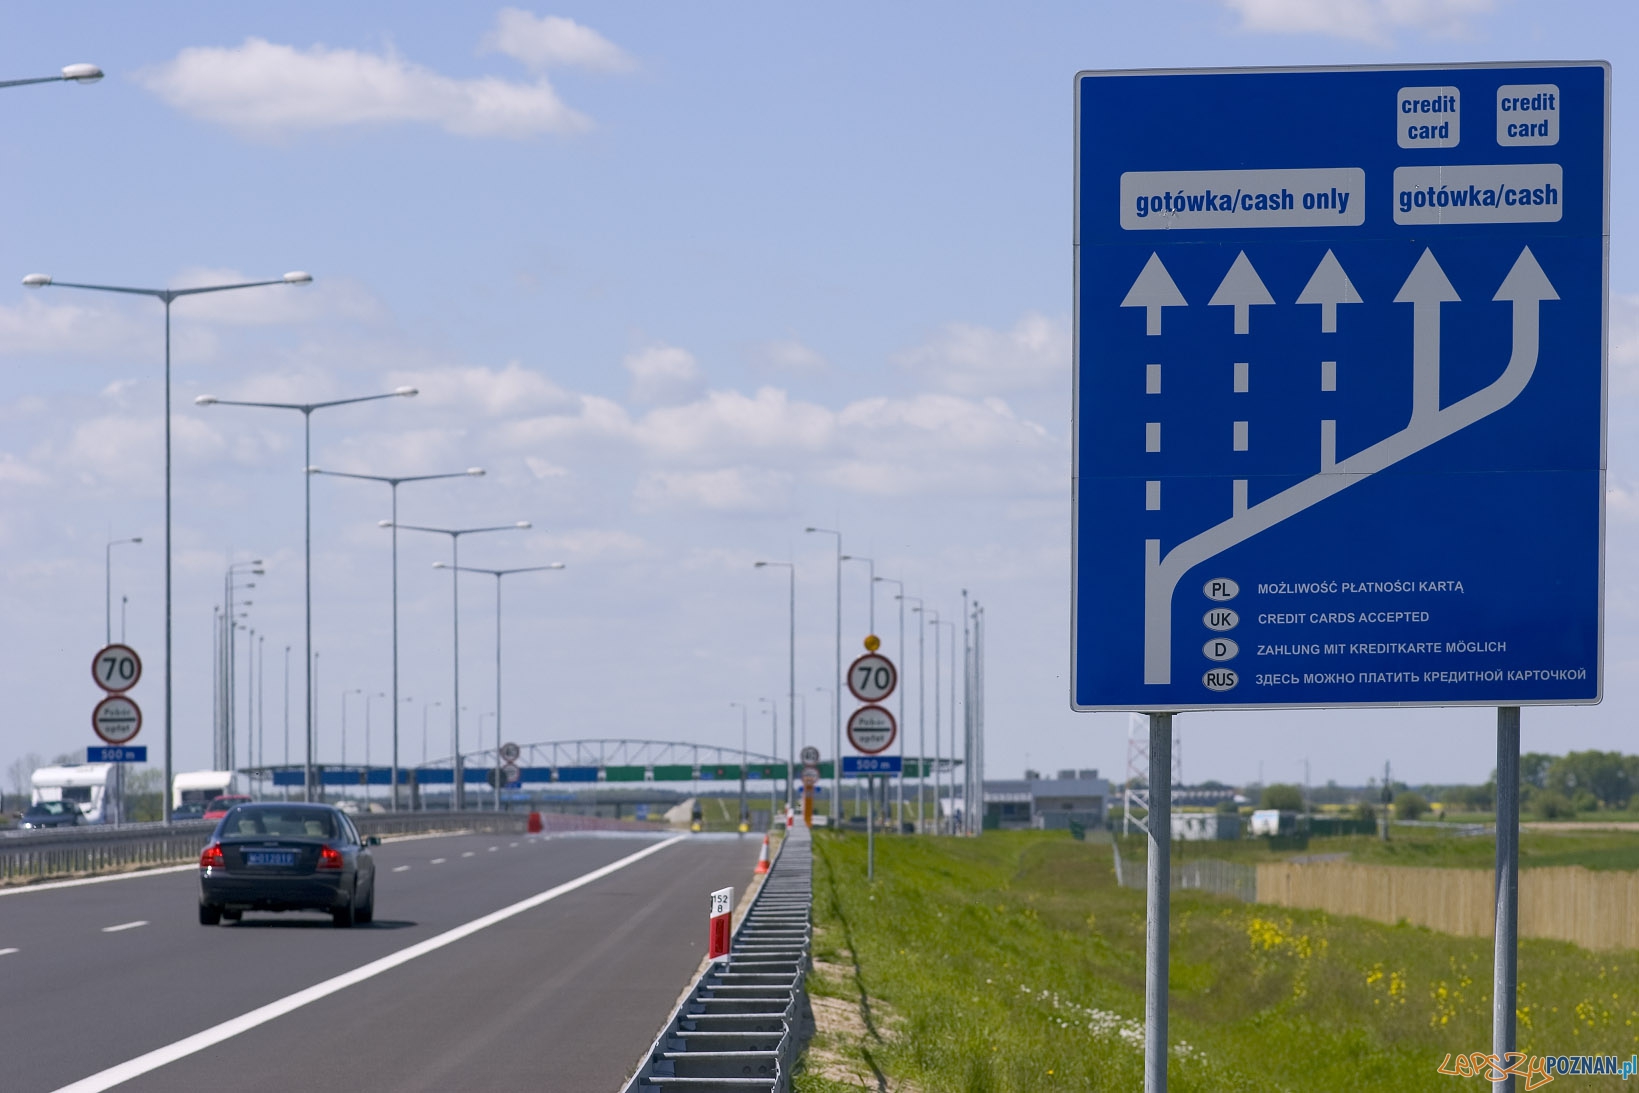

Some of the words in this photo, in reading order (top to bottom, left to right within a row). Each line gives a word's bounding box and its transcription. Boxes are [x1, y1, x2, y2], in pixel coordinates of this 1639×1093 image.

[1401, 95, 1456, 114] credit
[1501, 92, 1556, 112] credit
[1407, 121, 1449, 140] card
[1507, 119, 1549, 138] card
[1136, 188, 1294, 218] gotówka/cash
[1302, 187, 1350, 215] only
[1399, 183, 1558, 213] gotówka/cash
[1212, 582, 1231, 597] PL
[1258, 580, 1338, 594] MOŻLIWOŚĆ
[1341, 579, 1415, 593] PŁATNOŚCI
[1419, 580, 1465, 594] KARTĄ
[1210, 612, 1231, 626] UK
[1258, 613, 1307, 625] CREDIT
[1309, 612, 1356, 624] CARDS
[1358, 611, 1430, 623] ACCEPTED
[1214, 642, 1227, 657] D
[1256, 644, 1320, 656] ZAHLUNG
[1324, 643, 1346, 655] MIT
[1350, 642, 1442, 654] KREDITKARTE
[1446, 640, 1506, 653] MÖGLICH
[102, 657, 134, 681] 70
[858, 666, 890, 690] 70
[1255, 673, 1300, 686] ЗДЕСЬ
[1303, 672, 1355, 684] МОЖНО
[1359, 672, 1420, 684] ПЛАТИТЬ
[1423, 669, 1503, 684] КРЕДИТНОЙ
[1507, 668, 1586, 682] КАРТОЧКОЙ
[1206, 673, 1234, 687] RUS
